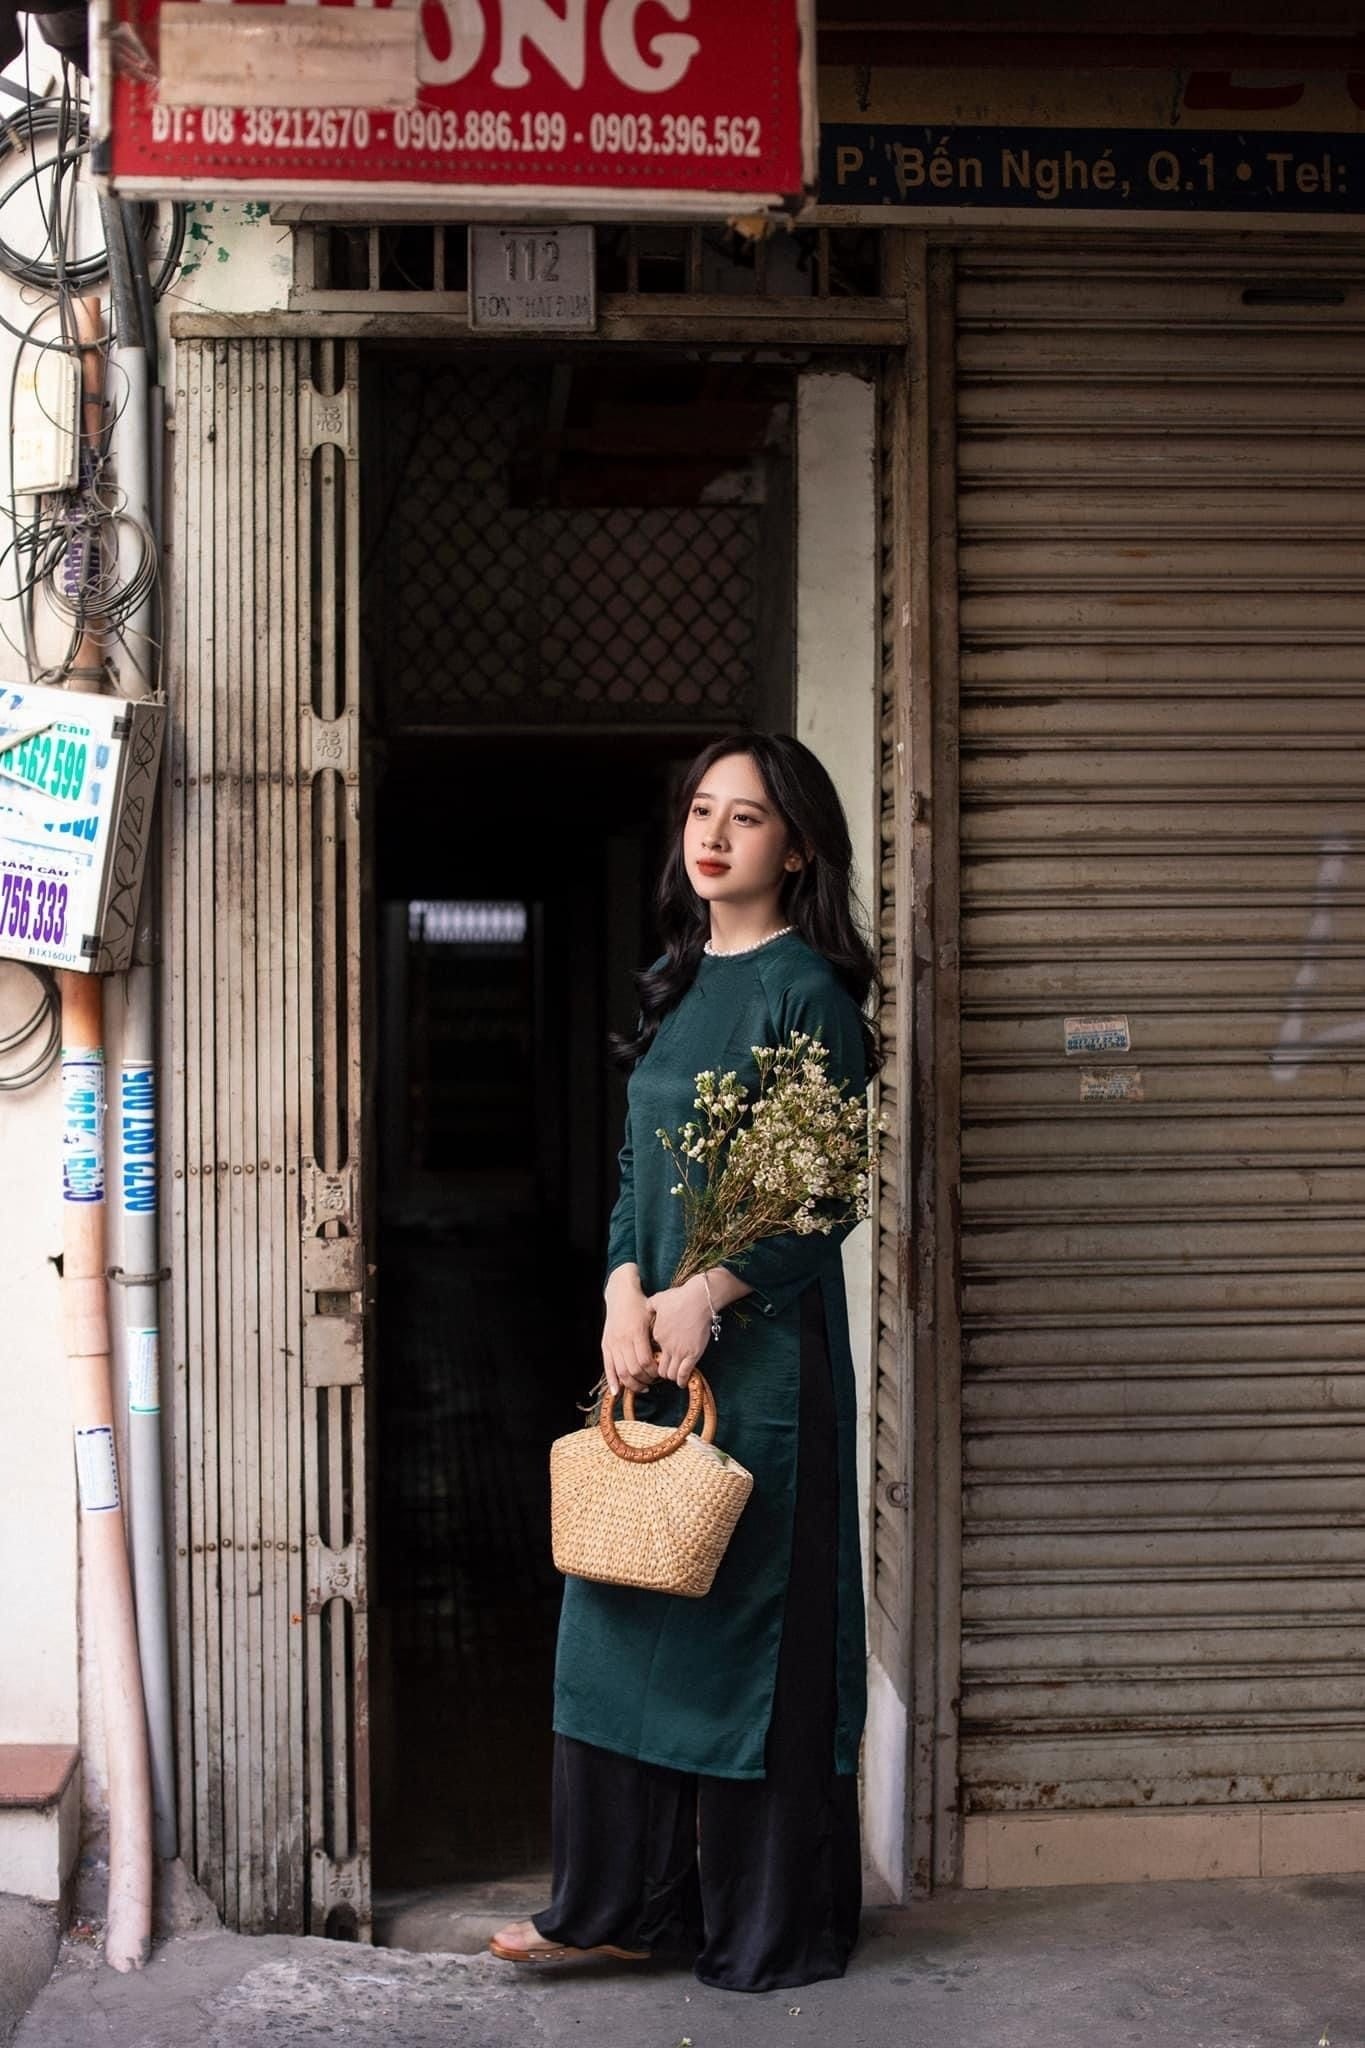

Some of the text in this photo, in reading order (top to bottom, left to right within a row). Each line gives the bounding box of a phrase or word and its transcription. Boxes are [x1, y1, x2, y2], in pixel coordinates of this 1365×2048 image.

[202, 105, 235, 144] 08
[242, 107, 370, 149] 38212670
[393, 109, 567, 151] 0903.886.199
[589, 112, 761, 157] 0903.396.562
[836, 135, 1348, 199] P. Bến Nghé, Q.1 Tel:
[504, 239, 560, 282] 112
[51, 738, 87, 801] 599
[0, 873, 68, 945] 756.333
